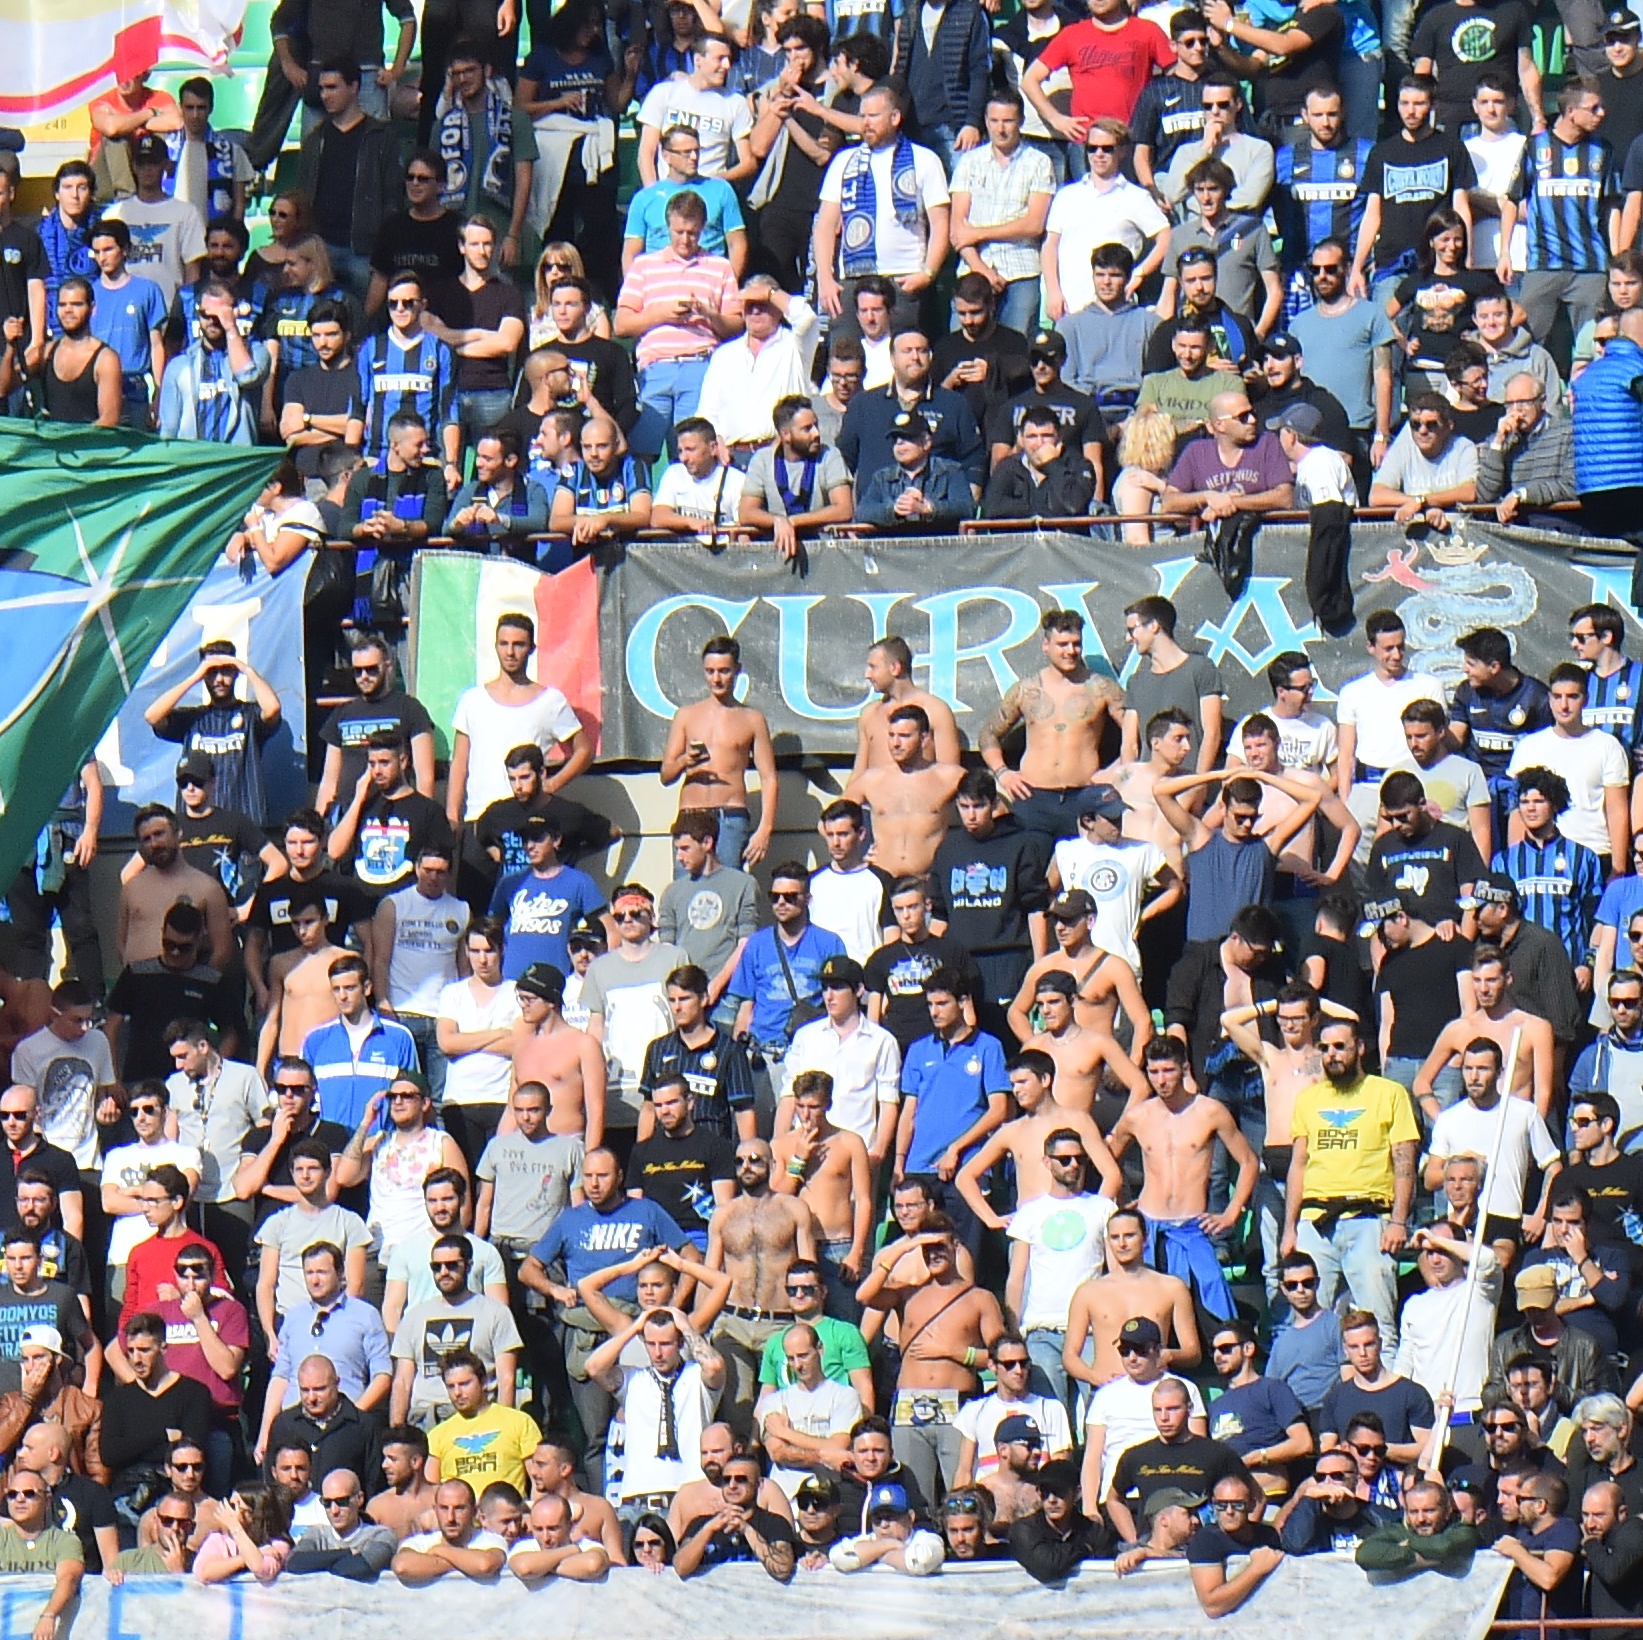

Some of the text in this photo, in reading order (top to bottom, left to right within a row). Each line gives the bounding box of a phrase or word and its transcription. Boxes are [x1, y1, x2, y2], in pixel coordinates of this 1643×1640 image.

[624, 555, 1340, 722] CURVA
[1317, 1130, 1358, 1139] BOYS
[587, 1223, 643, 1251] NIKE
